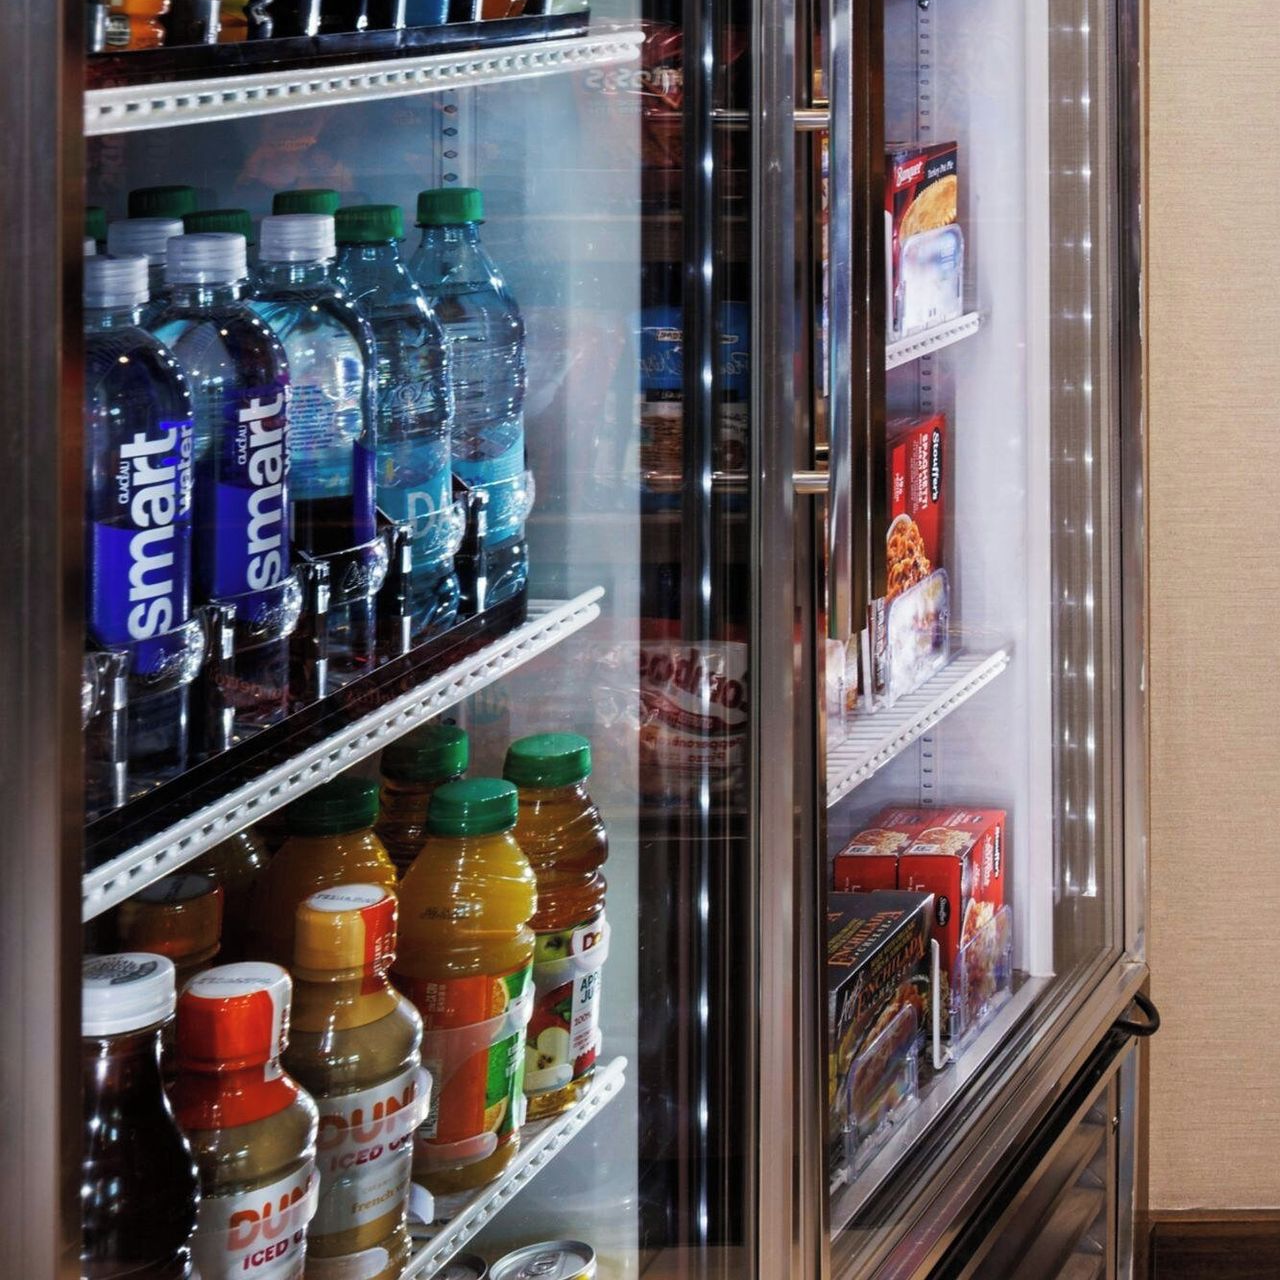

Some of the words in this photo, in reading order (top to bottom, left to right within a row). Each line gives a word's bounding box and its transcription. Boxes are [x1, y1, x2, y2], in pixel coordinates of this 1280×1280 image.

[120, 431, 178, 642] smart
[238, 393, 284, 593] smart
[243, 1239, 289, 1270] ICED
